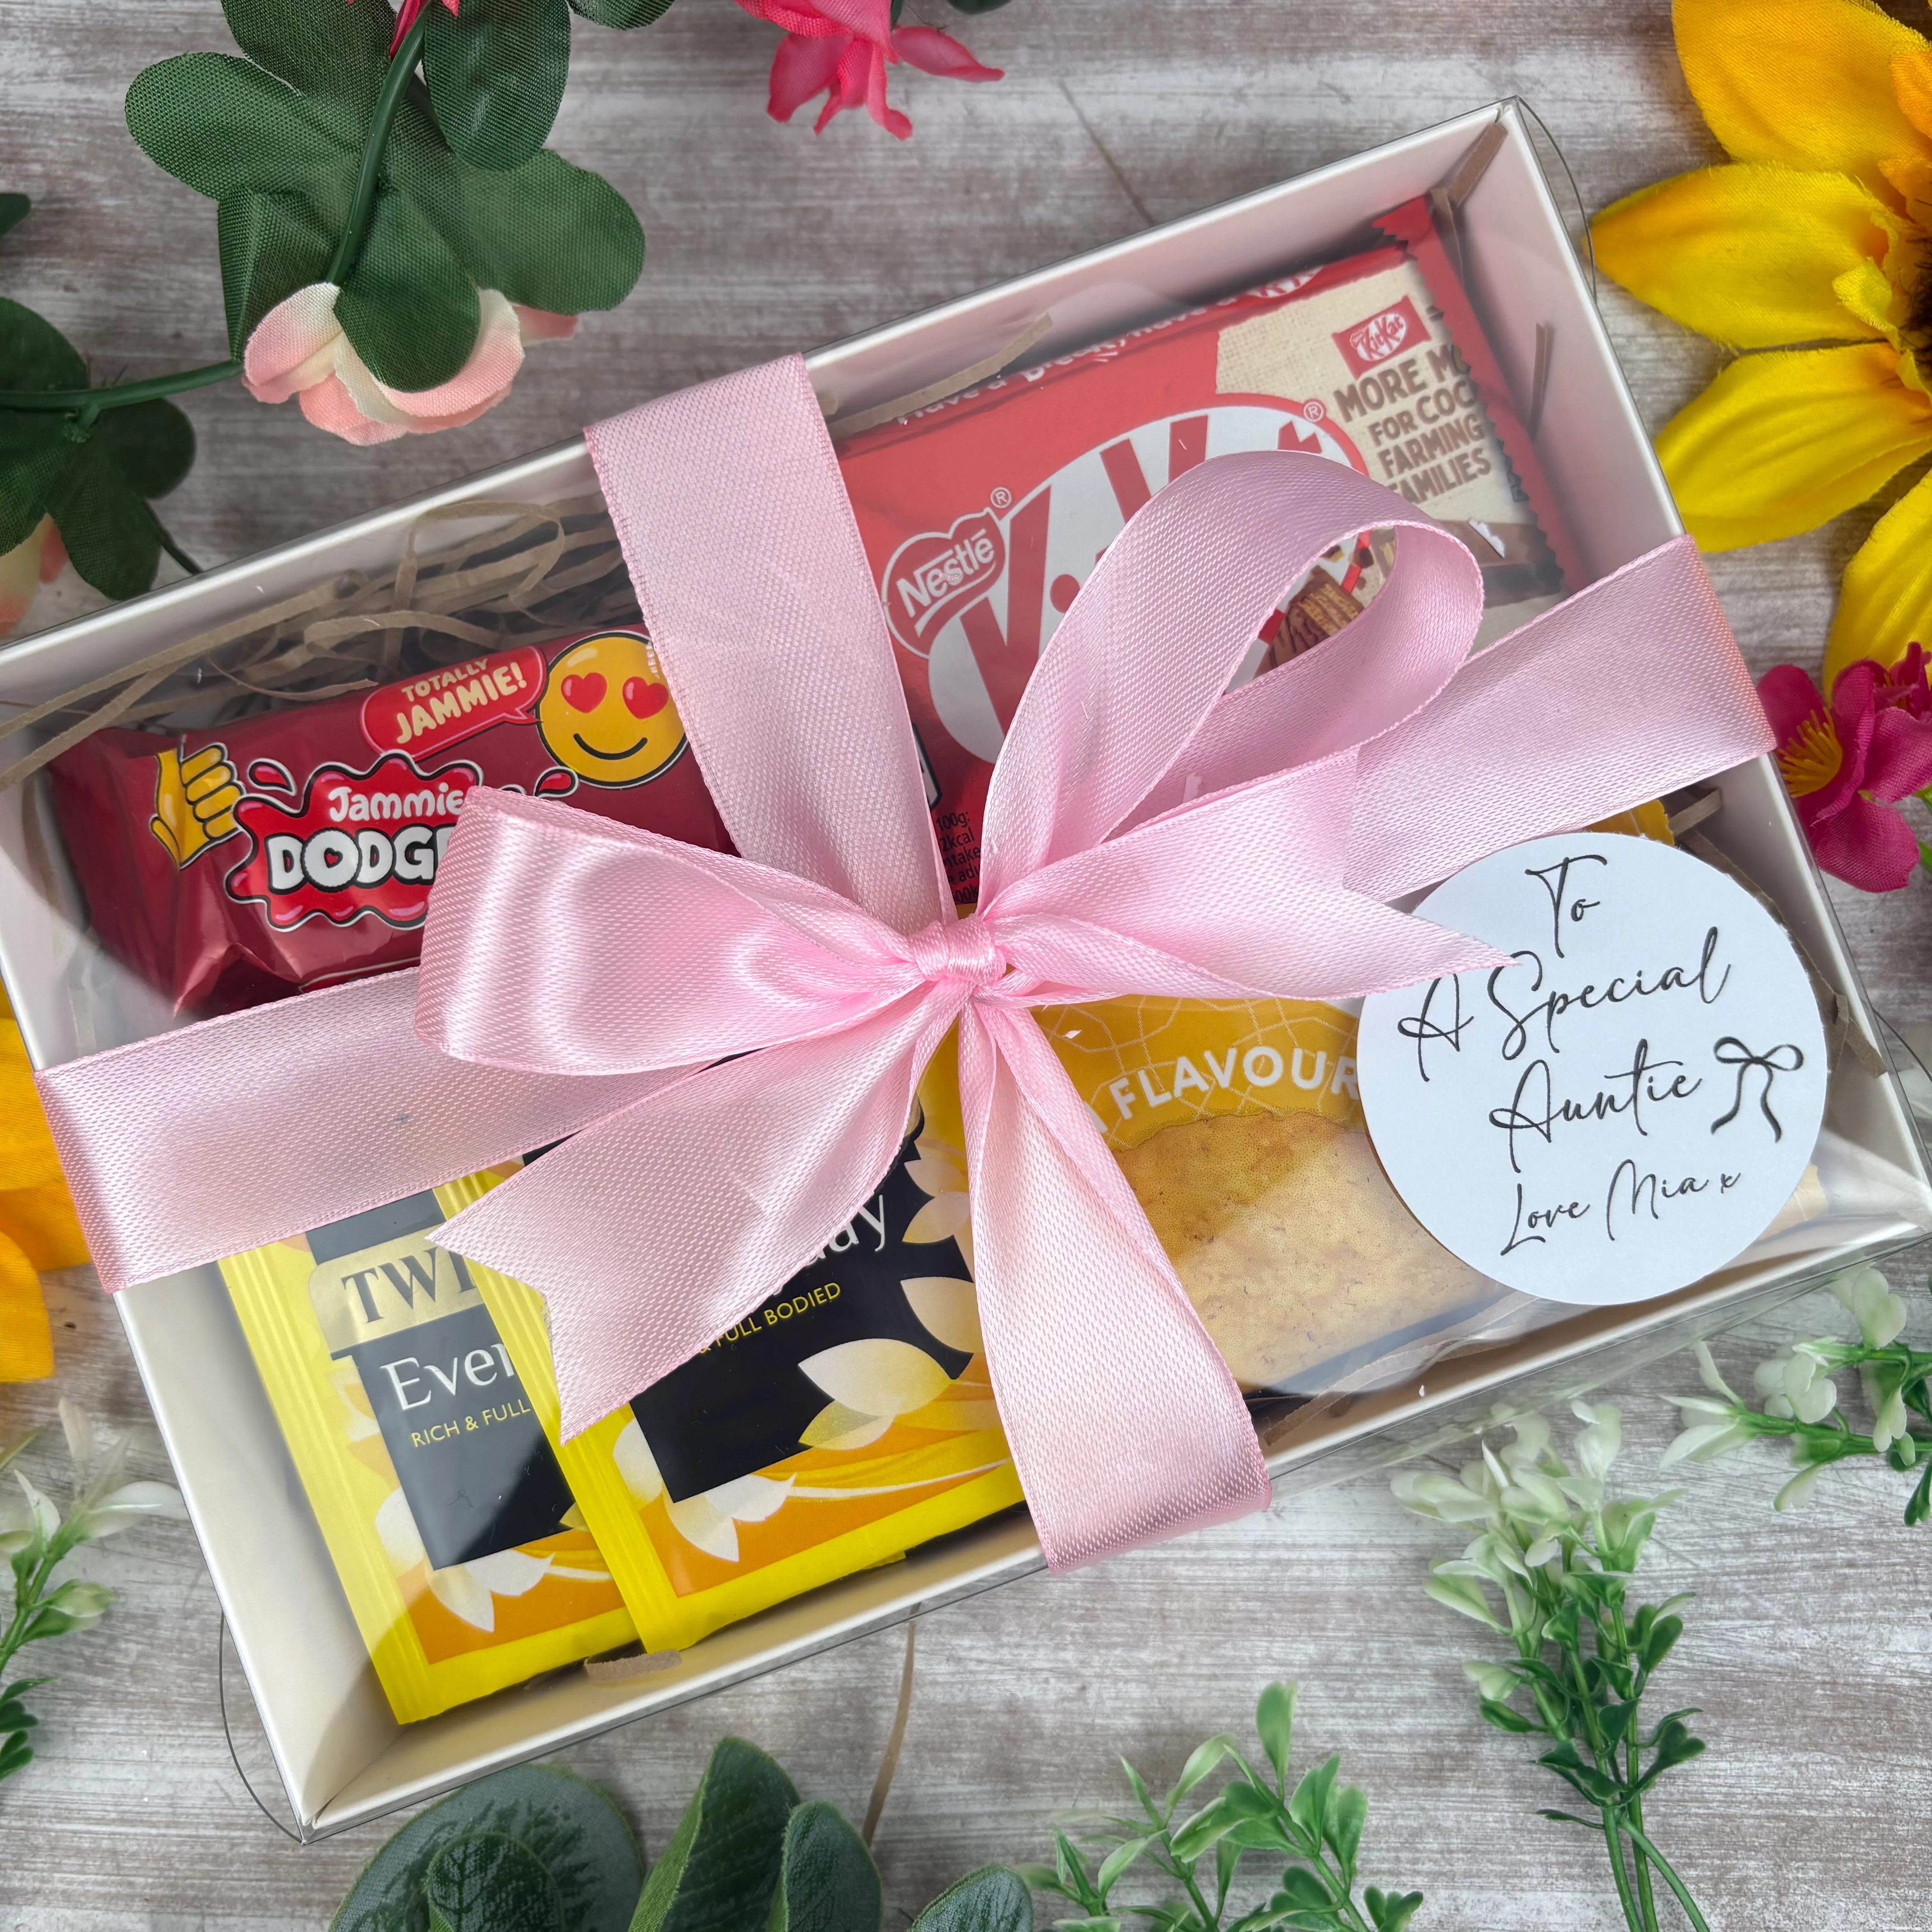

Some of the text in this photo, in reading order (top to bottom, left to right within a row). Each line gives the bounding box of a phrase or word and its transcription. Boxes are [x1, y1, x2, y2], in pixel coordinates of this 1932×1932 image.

[1333, 358, 1427, 423] MORE
[1368, 410, 1418, 447] FOR
[1377, 413, 1485, 479] FARMING
[396, 662, 527, 744] JAMMIE!
[401, 658, 488, 702] TOTALLY
[328, 782, 464, 822] Jammie
[1525, 855, 1607, 958] To
[1397, 926, 1731, 1082] A Special
[1108, 1045, 1358, 1120] FLAVOUR
[1489, 1038, 1702, 1173] Auntie
[1500, 1159, 1742, 1256] Love Mia x
[764, 1282, 842, 1326] BODIED
[411, 1399, 531, 1448] RICH & FULL
